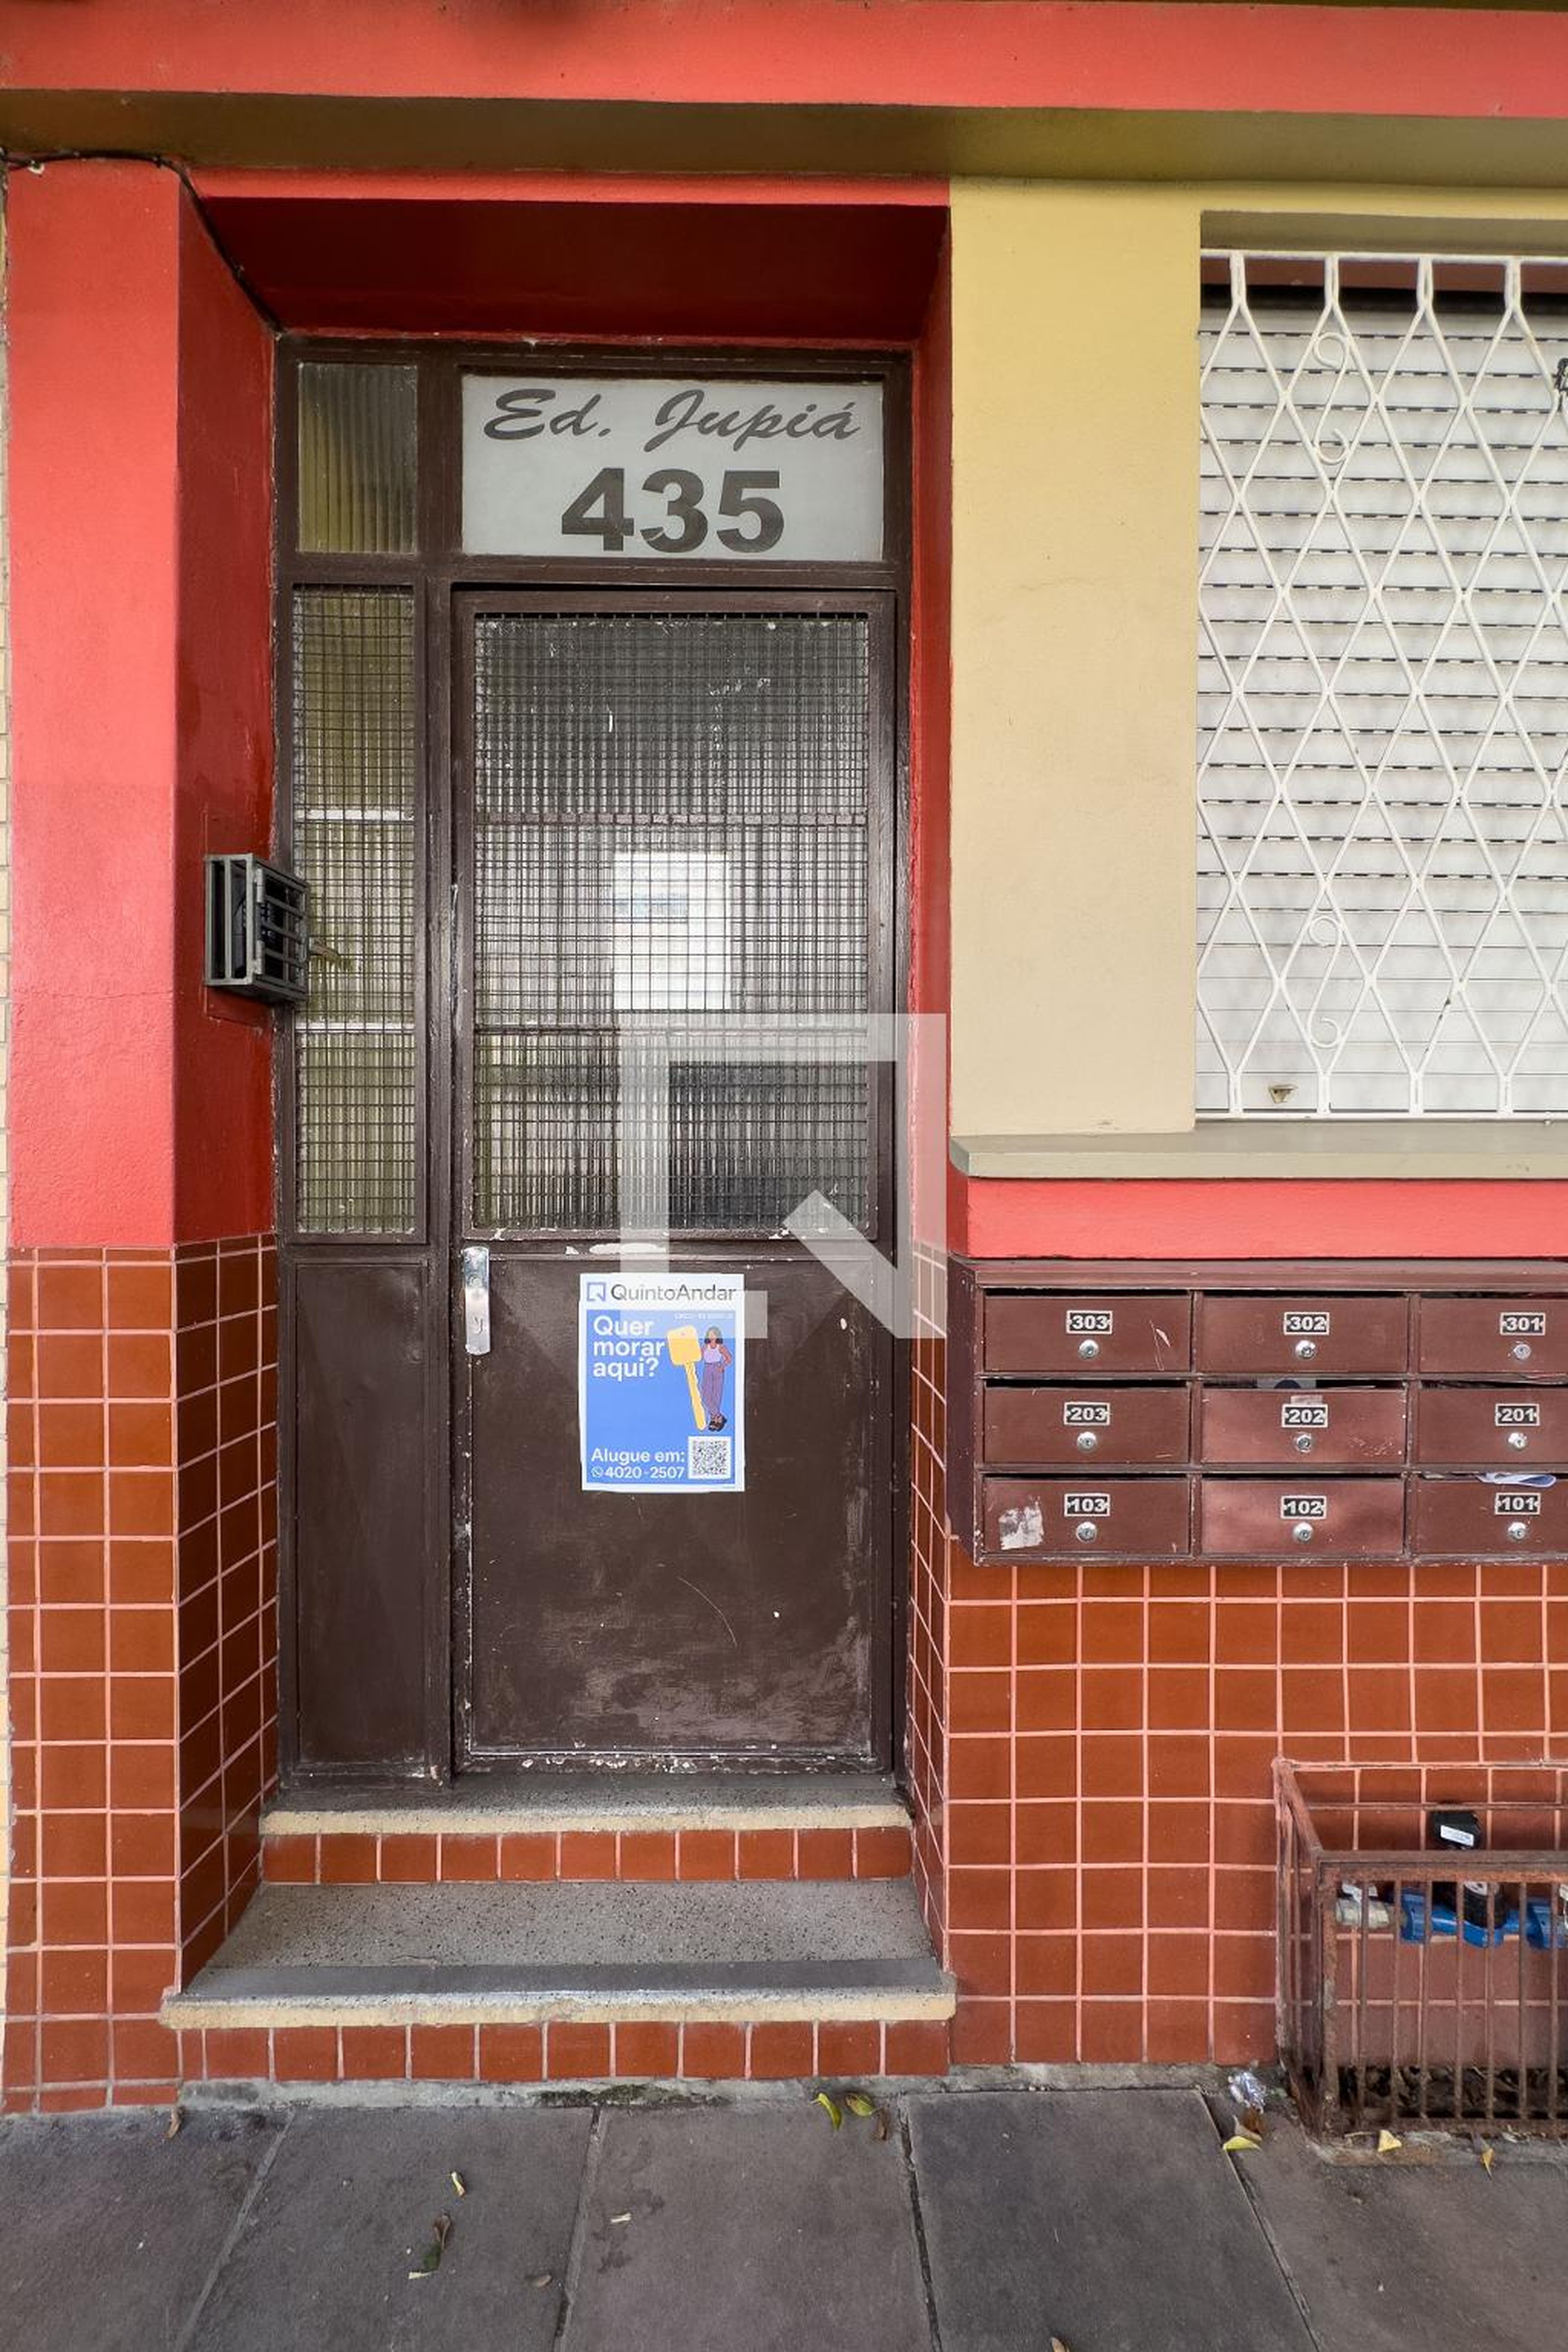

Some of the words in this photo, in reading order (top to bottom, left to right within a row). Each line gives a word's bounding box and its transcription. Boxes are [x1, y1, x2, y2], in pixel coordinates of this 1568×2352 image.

[483, 388, 612, 440] Ed.
[644, 389, 861, 452] Jupiá
[561, 467, 784, 553] 435
[611, 1284, 736, 1301] QuintoAndar
[593, 1315, 653, 1336] Quer
[1071, 1315, 1108, 1330] 303
[1290, 1316, 1325, 1331] 302
[1506, 1317, 1540, 1331] 301
[593, 1340, 665, 1356] morar
[593, 1358, 659, 1381] aqui?
[1070, 1407, 1106, 1421] 203
[1288, 1409, 1324, 1423] 202
[1501, 1408, 1534, 1421] 201
[591, 1448, 650, 1465] Alugue
[655, 1451, 685, 1463] em:
[1071, 1498, 1106, 1512] 103
[1287, 1501, 1322, 1515] 102
[1501, 1497, 1535, 1510] 101
